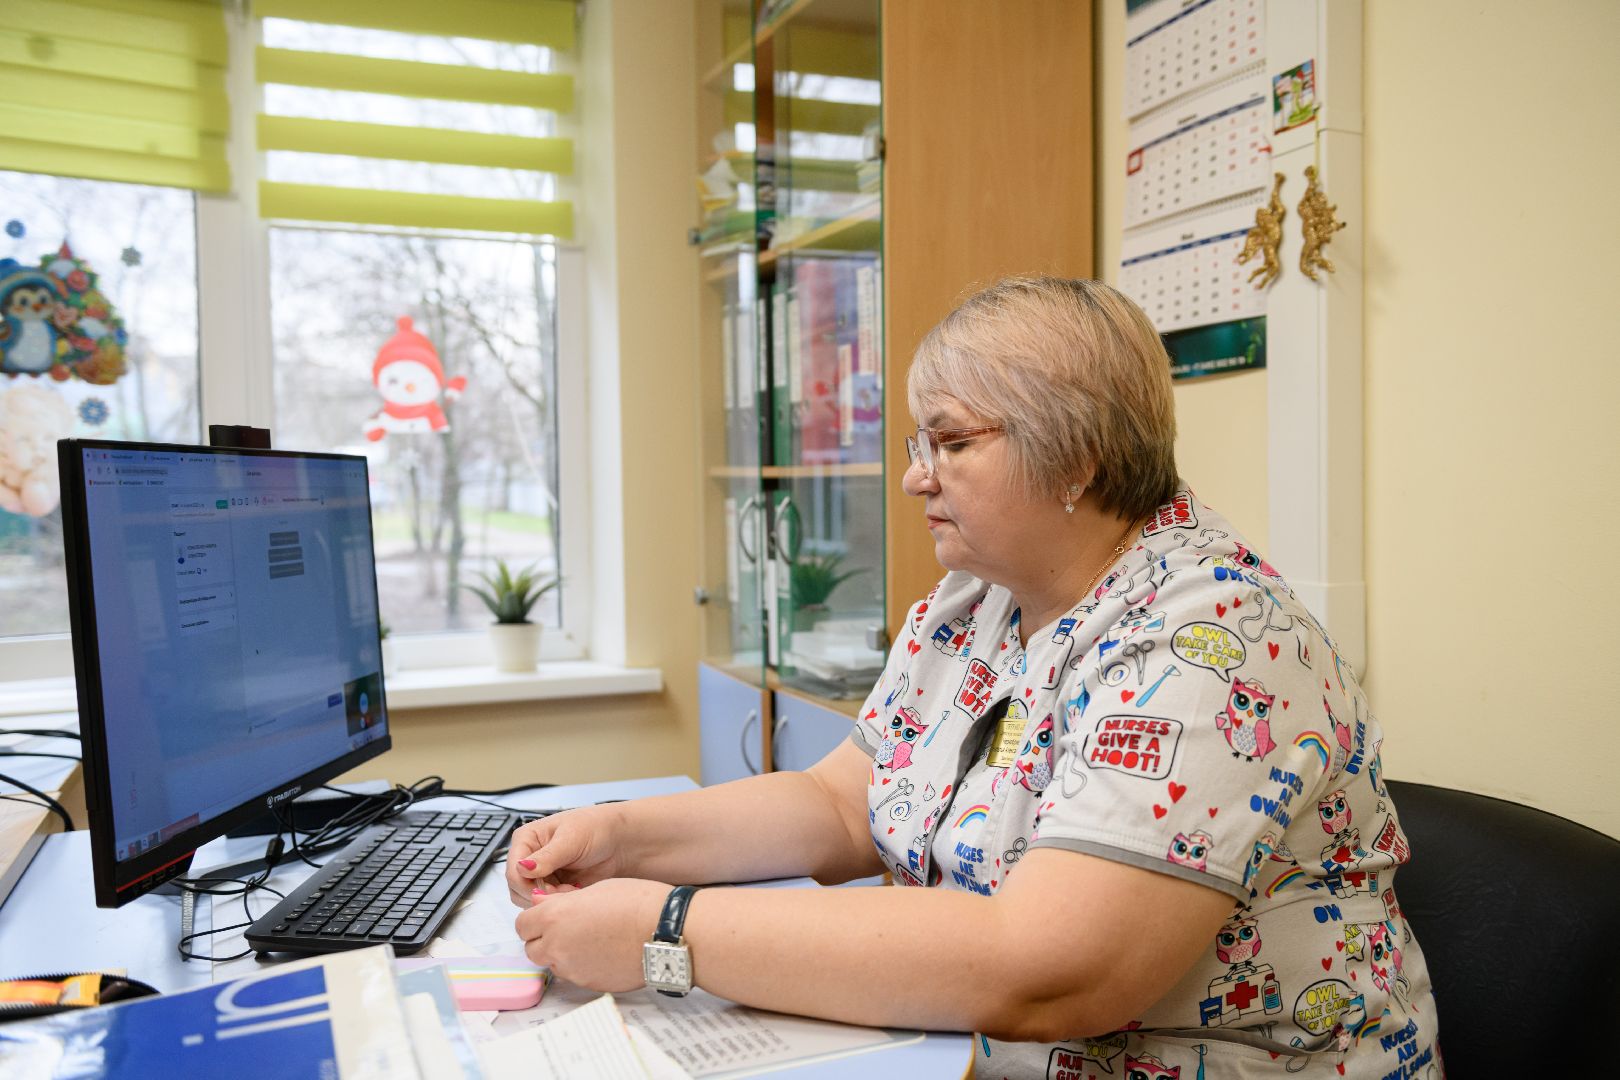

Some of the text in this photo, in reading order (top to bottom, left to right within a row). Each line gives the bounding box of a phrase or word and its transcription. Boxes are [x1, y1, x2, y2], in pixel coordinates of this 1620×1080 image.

[1192, 625, 1231, 646] OWL
[1176, 635, 1243, 661] TAKE CARE
[1185, 650, 1228, 668] OF YOU
[1104, 719, 1171, 736] NURSES
[1098, 732, 1160, 753] GIVE A
[1091, 747, 1161, 773] HOOT!
[1306, 984, 1340, 1006] OWL
[1297, 1005, 1323, 1021] TAKE
[1308, 1020, 1320, 1030] OF
[1086, 1044, 1108, 1058] YOU
